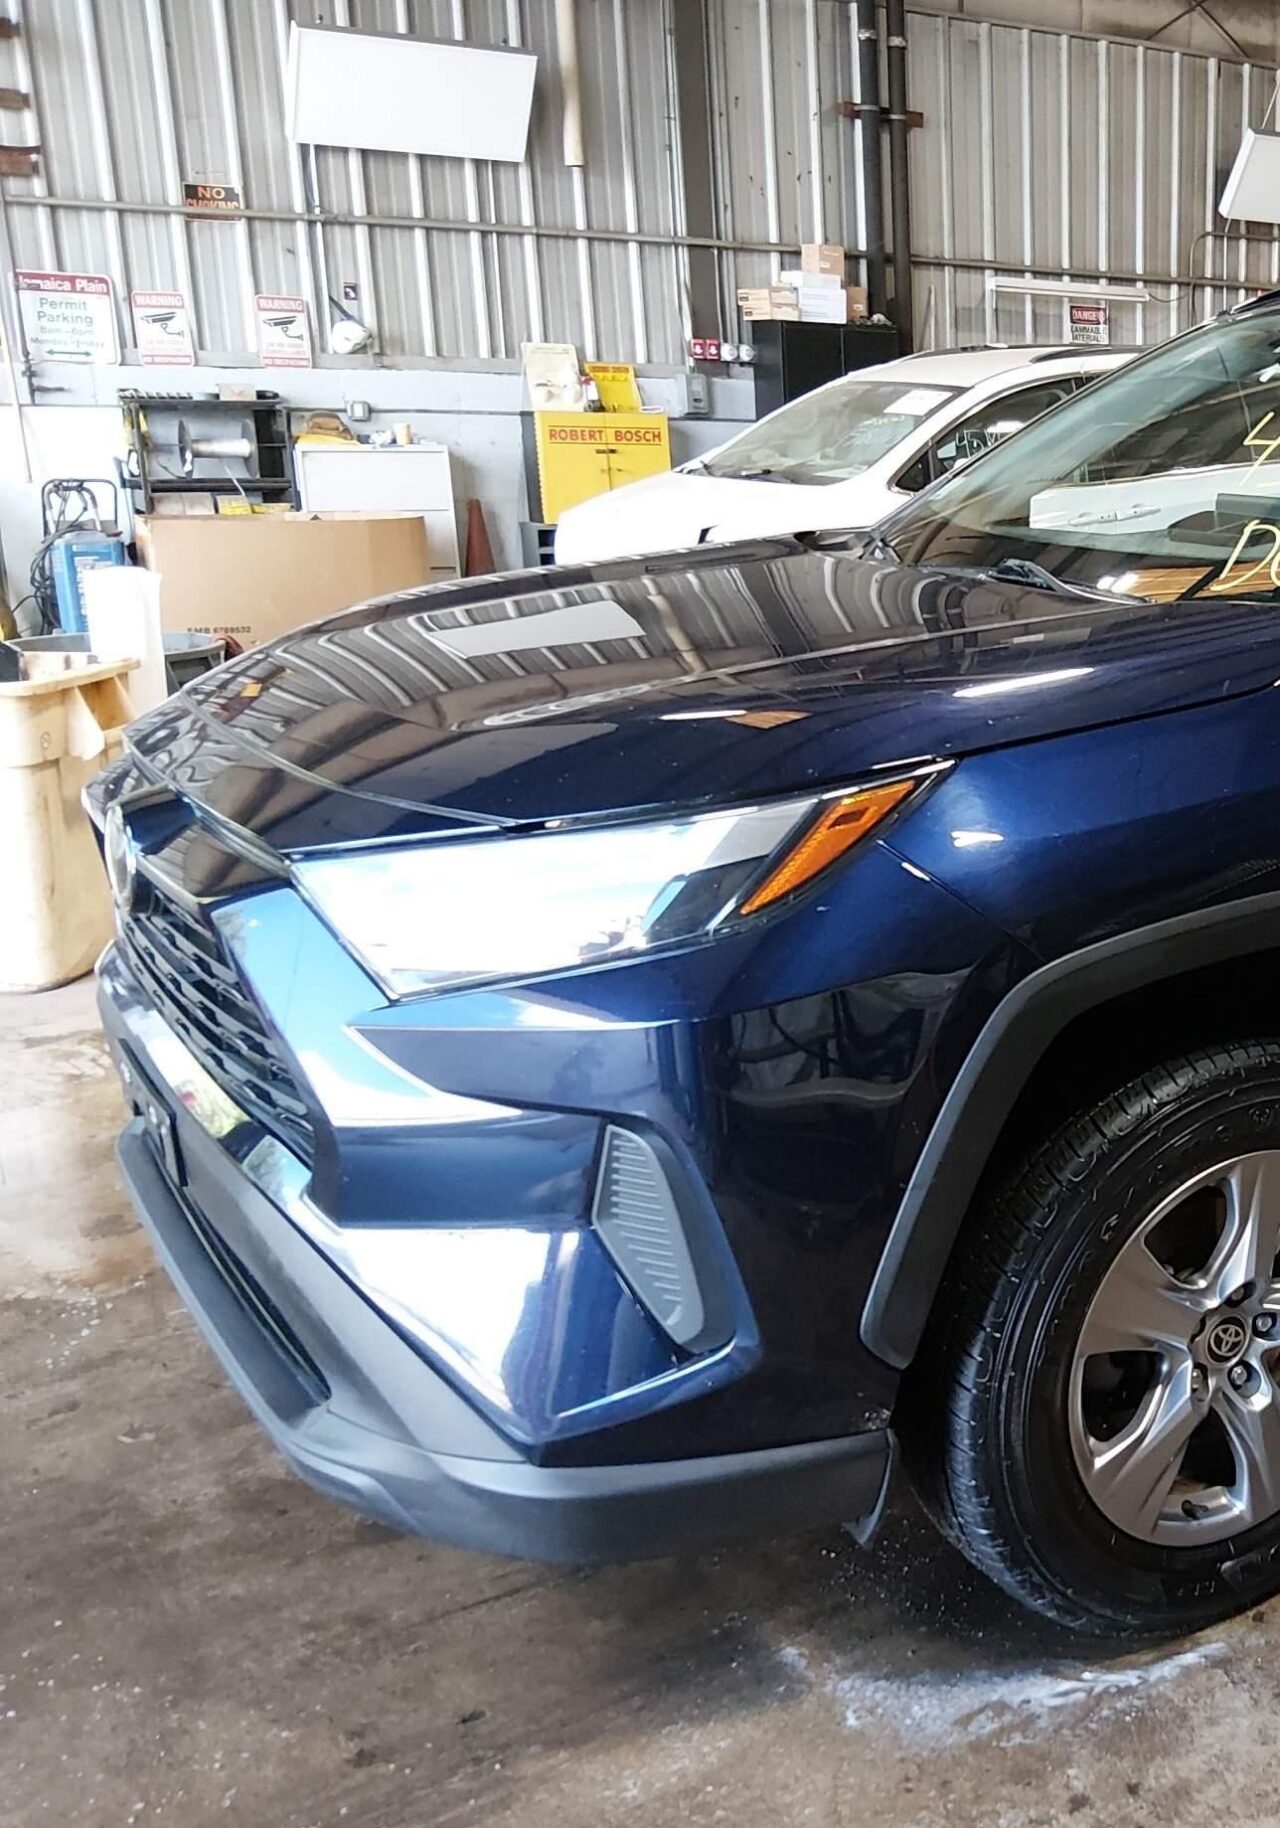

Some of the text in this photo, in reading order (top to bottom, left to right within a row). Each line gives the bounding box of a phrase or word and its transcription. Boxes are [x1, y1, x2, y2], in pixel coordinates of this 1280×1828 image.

[197, 187, 225, 199] NO
[75, 278, 107, 293] Plain
[39, 297, 87, 311] Permit
[134, 294, 184, 307] WARNING
[257, 298, 303, 311] WARNING
[37, 310, 93, 327] Parking
[549, 428, 662, 442] ROBERT BOSCH
